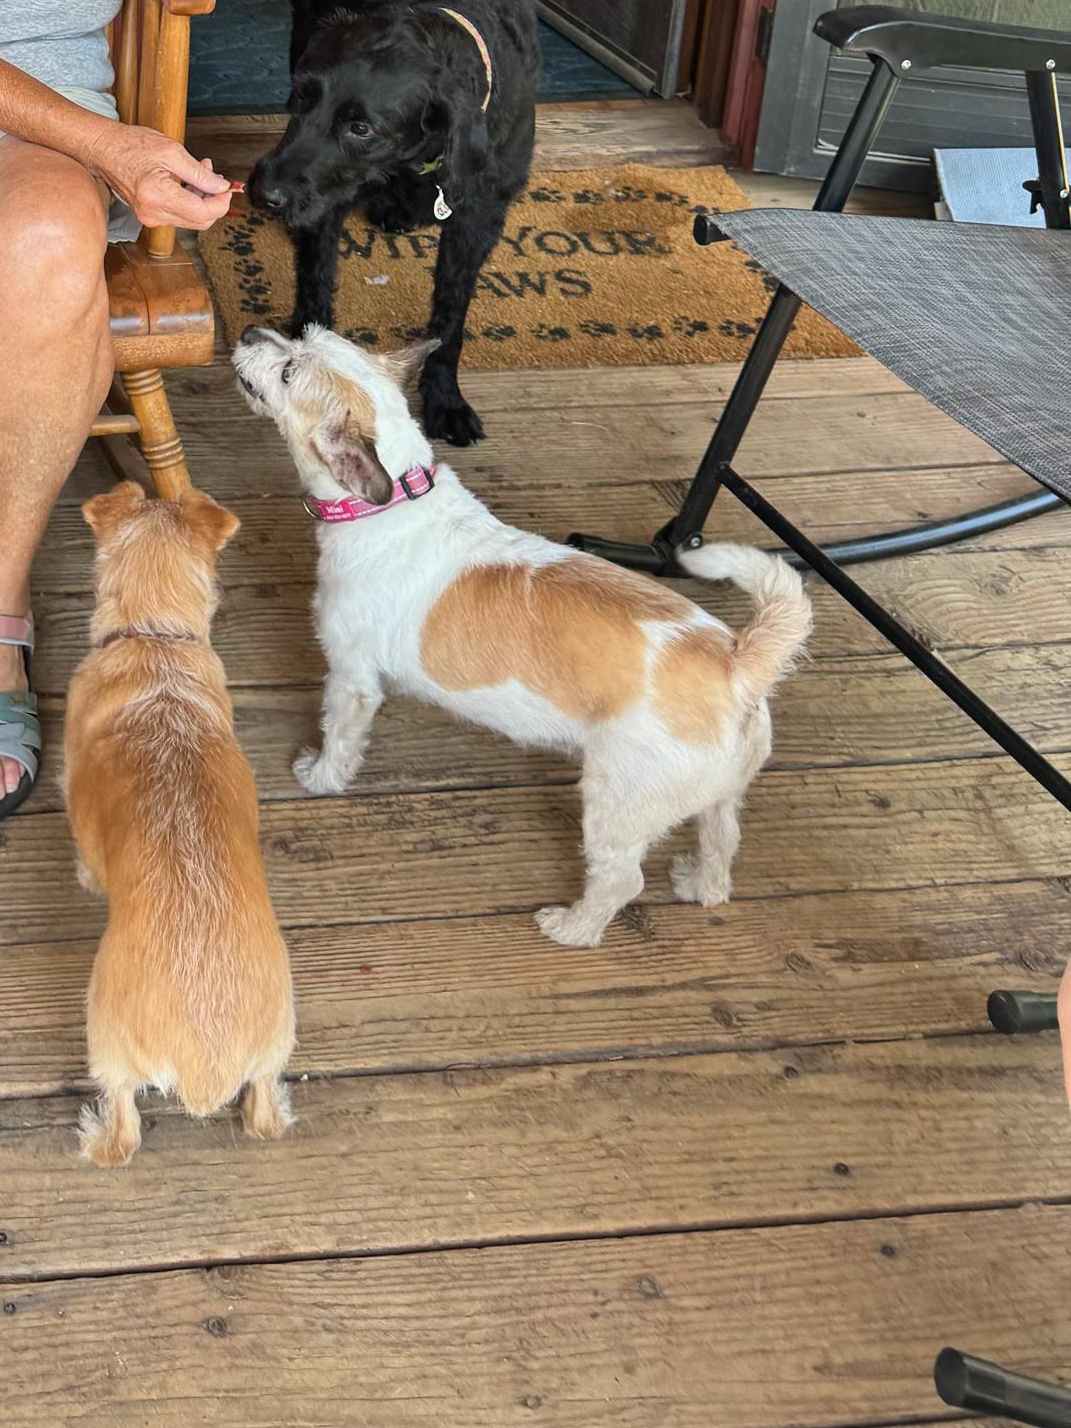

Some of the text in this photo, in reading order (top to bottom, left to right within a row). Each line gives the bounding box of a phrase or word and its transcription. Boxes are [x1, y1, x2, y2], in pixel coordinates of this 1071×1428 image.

[336, 225, 674, 260] WIP YOUR
[474, 268, 594, 300] AWS
